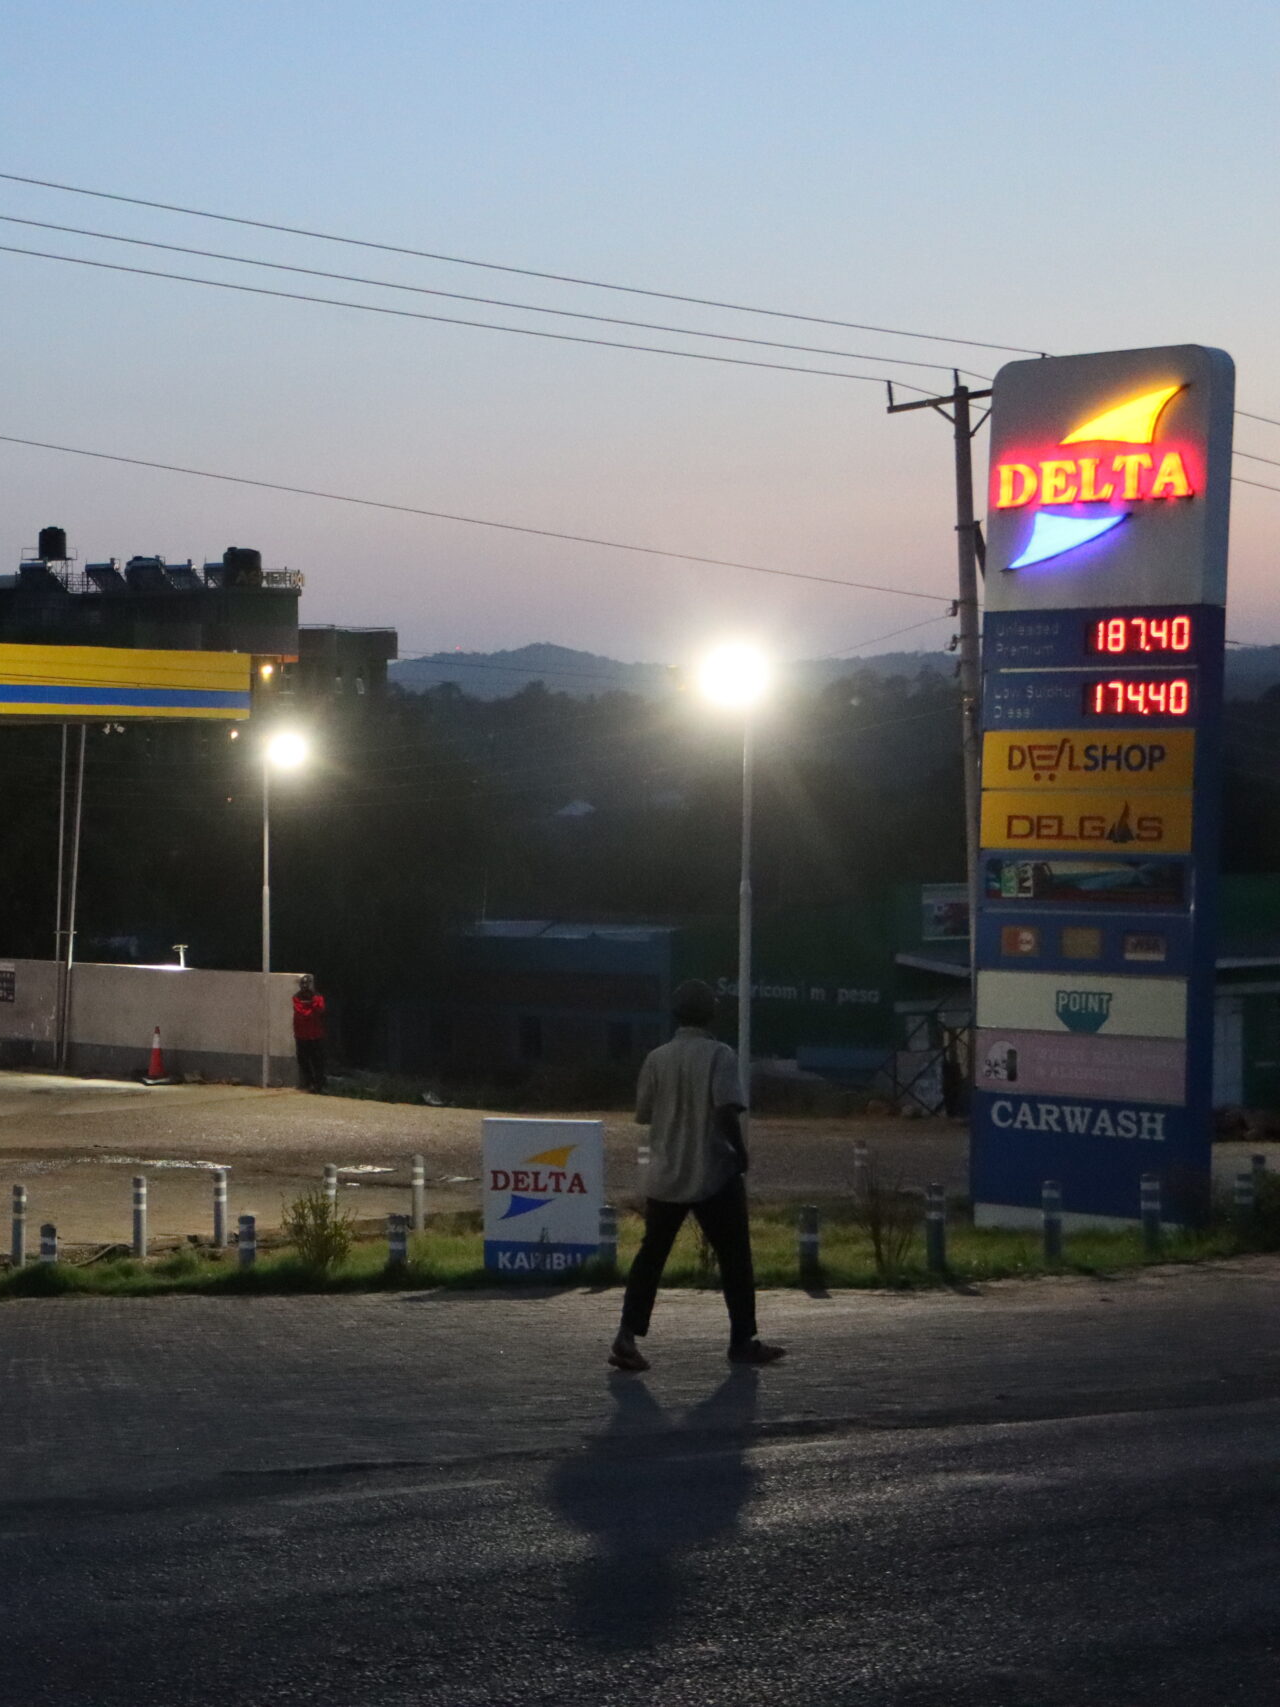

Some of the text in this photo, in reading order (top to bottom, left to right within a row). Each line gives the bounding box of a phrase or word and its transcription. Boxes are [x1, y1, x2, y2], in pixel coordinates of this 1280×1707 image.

[996, 452, 1195, 509] DELTA
[1097, 617, 1191, 652] 187.40
[1095, 681, 1189, 715] 174.40
[991, 1100, 1166, 1141] CARWASH
[490, 1170, 587, 1194] DELTA
